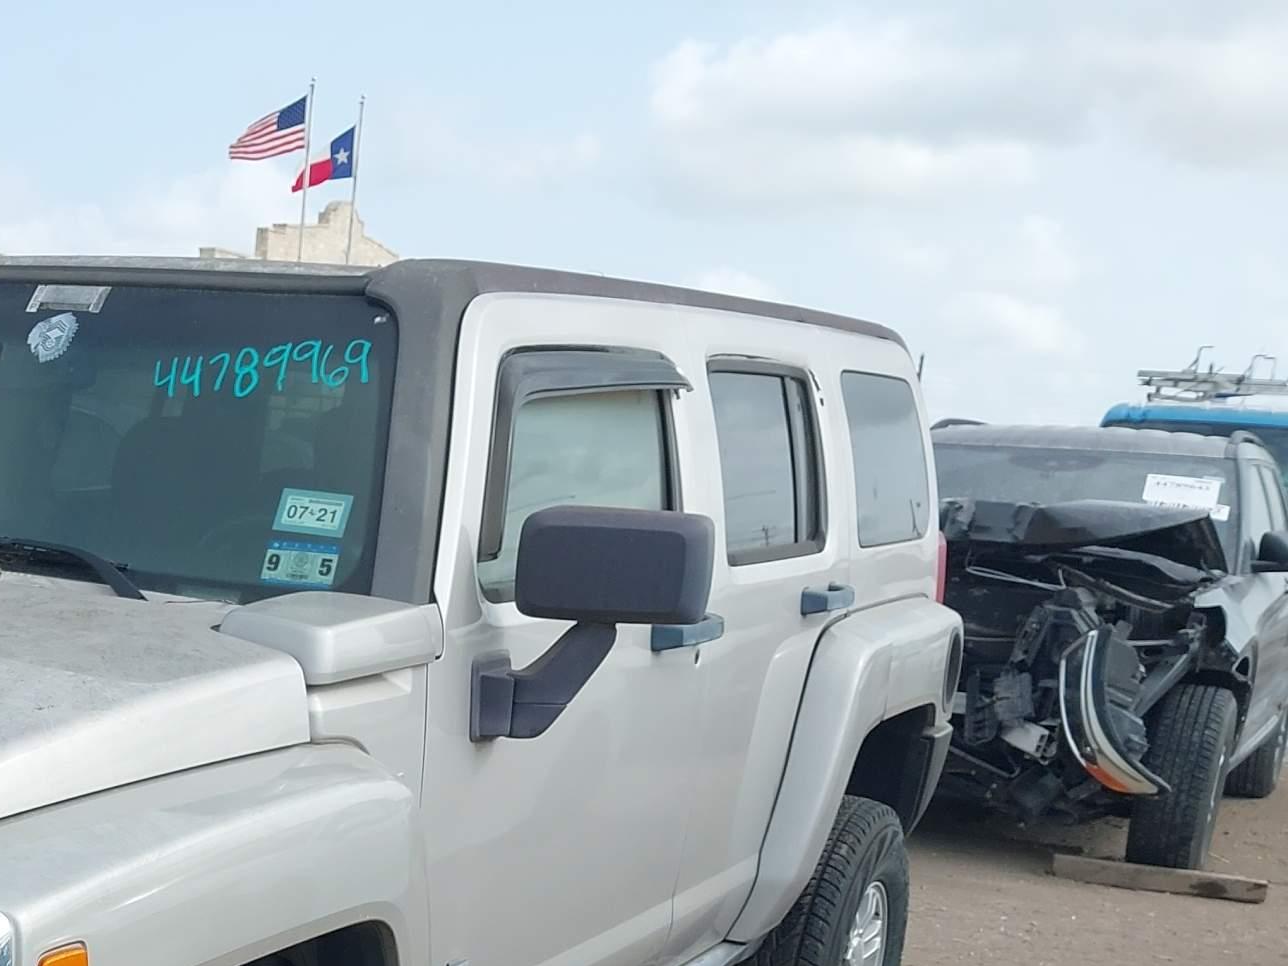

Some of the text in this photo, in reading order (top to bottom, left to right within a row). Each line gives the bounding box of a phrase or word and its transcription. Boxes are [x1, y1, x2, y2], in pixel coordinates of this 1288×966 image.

[153, 339, 372, 398] 44789969
[287, 504, 338, 523] 07 21
[266, 553, 281, 572] 9
[318, 558, 333, 577] 5
